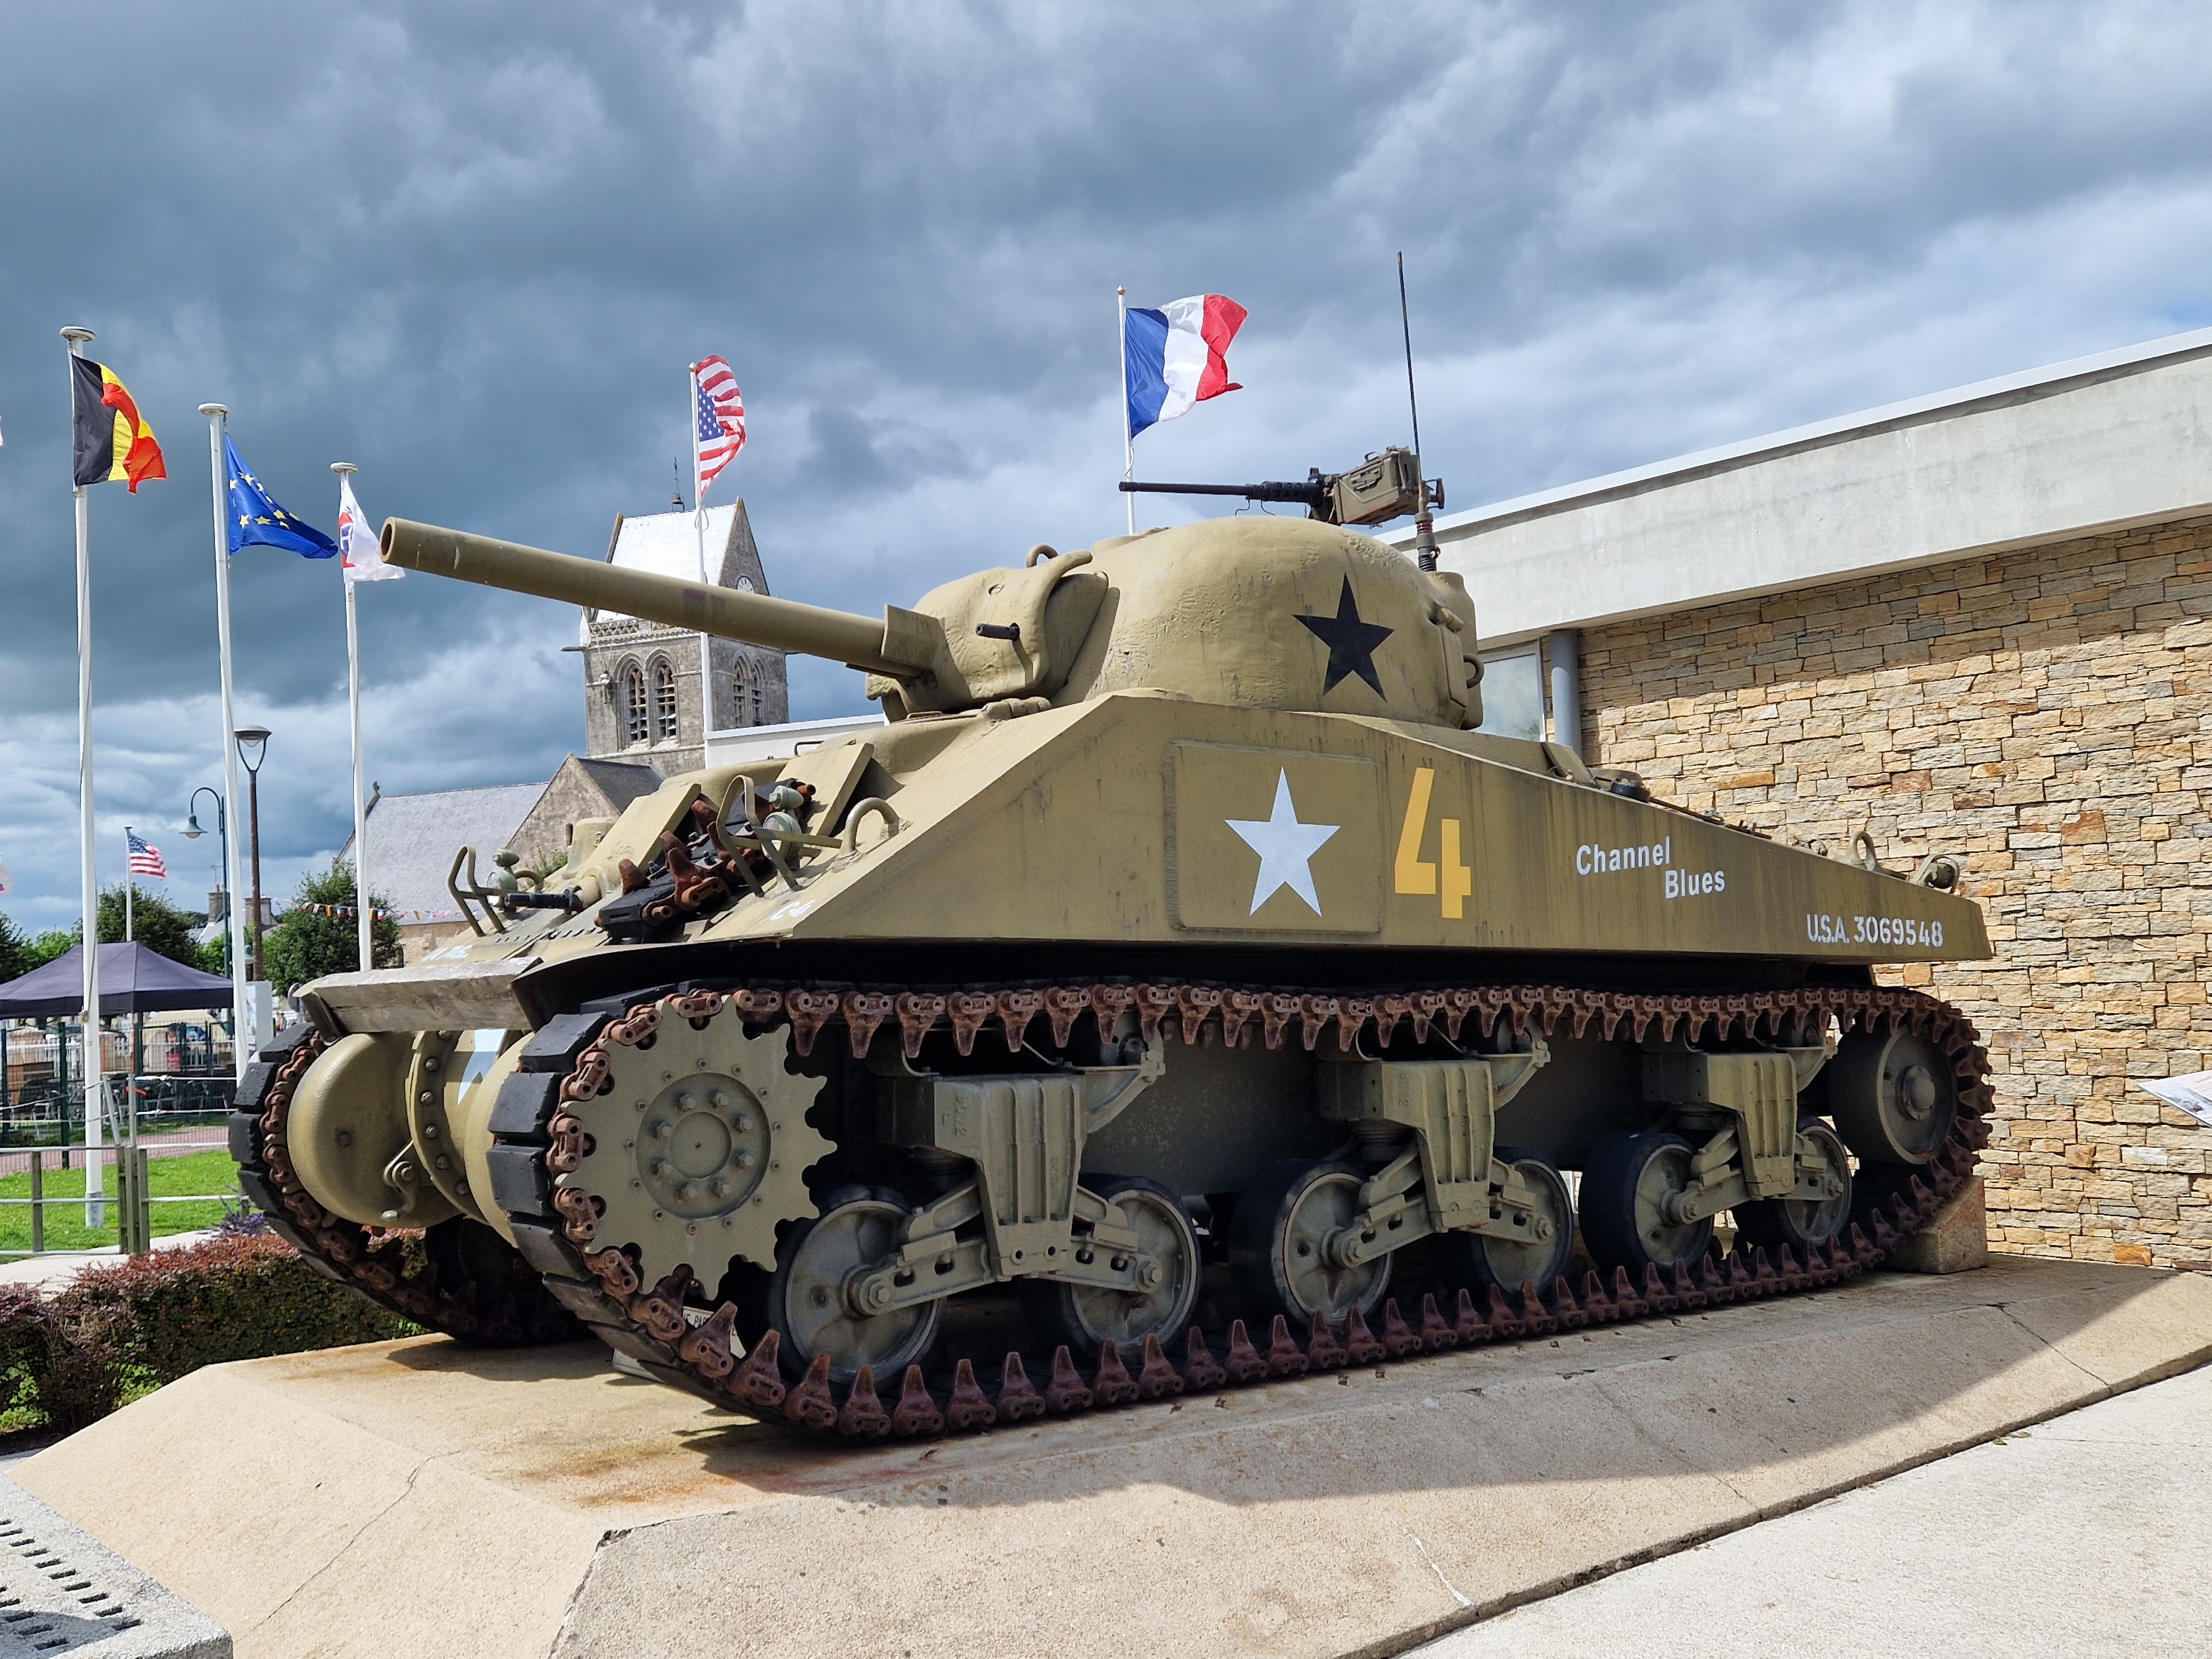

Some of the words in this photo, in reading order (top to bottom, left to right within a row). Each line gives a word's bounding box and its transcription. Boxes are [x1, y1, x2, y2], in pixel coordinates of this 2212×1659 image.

[1394, 766, 1472, 919] 4
[1576, 836, 1670, 875] Channel
[1665, 868, 1726, 899] Blues
[1806, 914, 1850, 944] U.S.A.
[1853, 916, 1944, 947] 3069548
